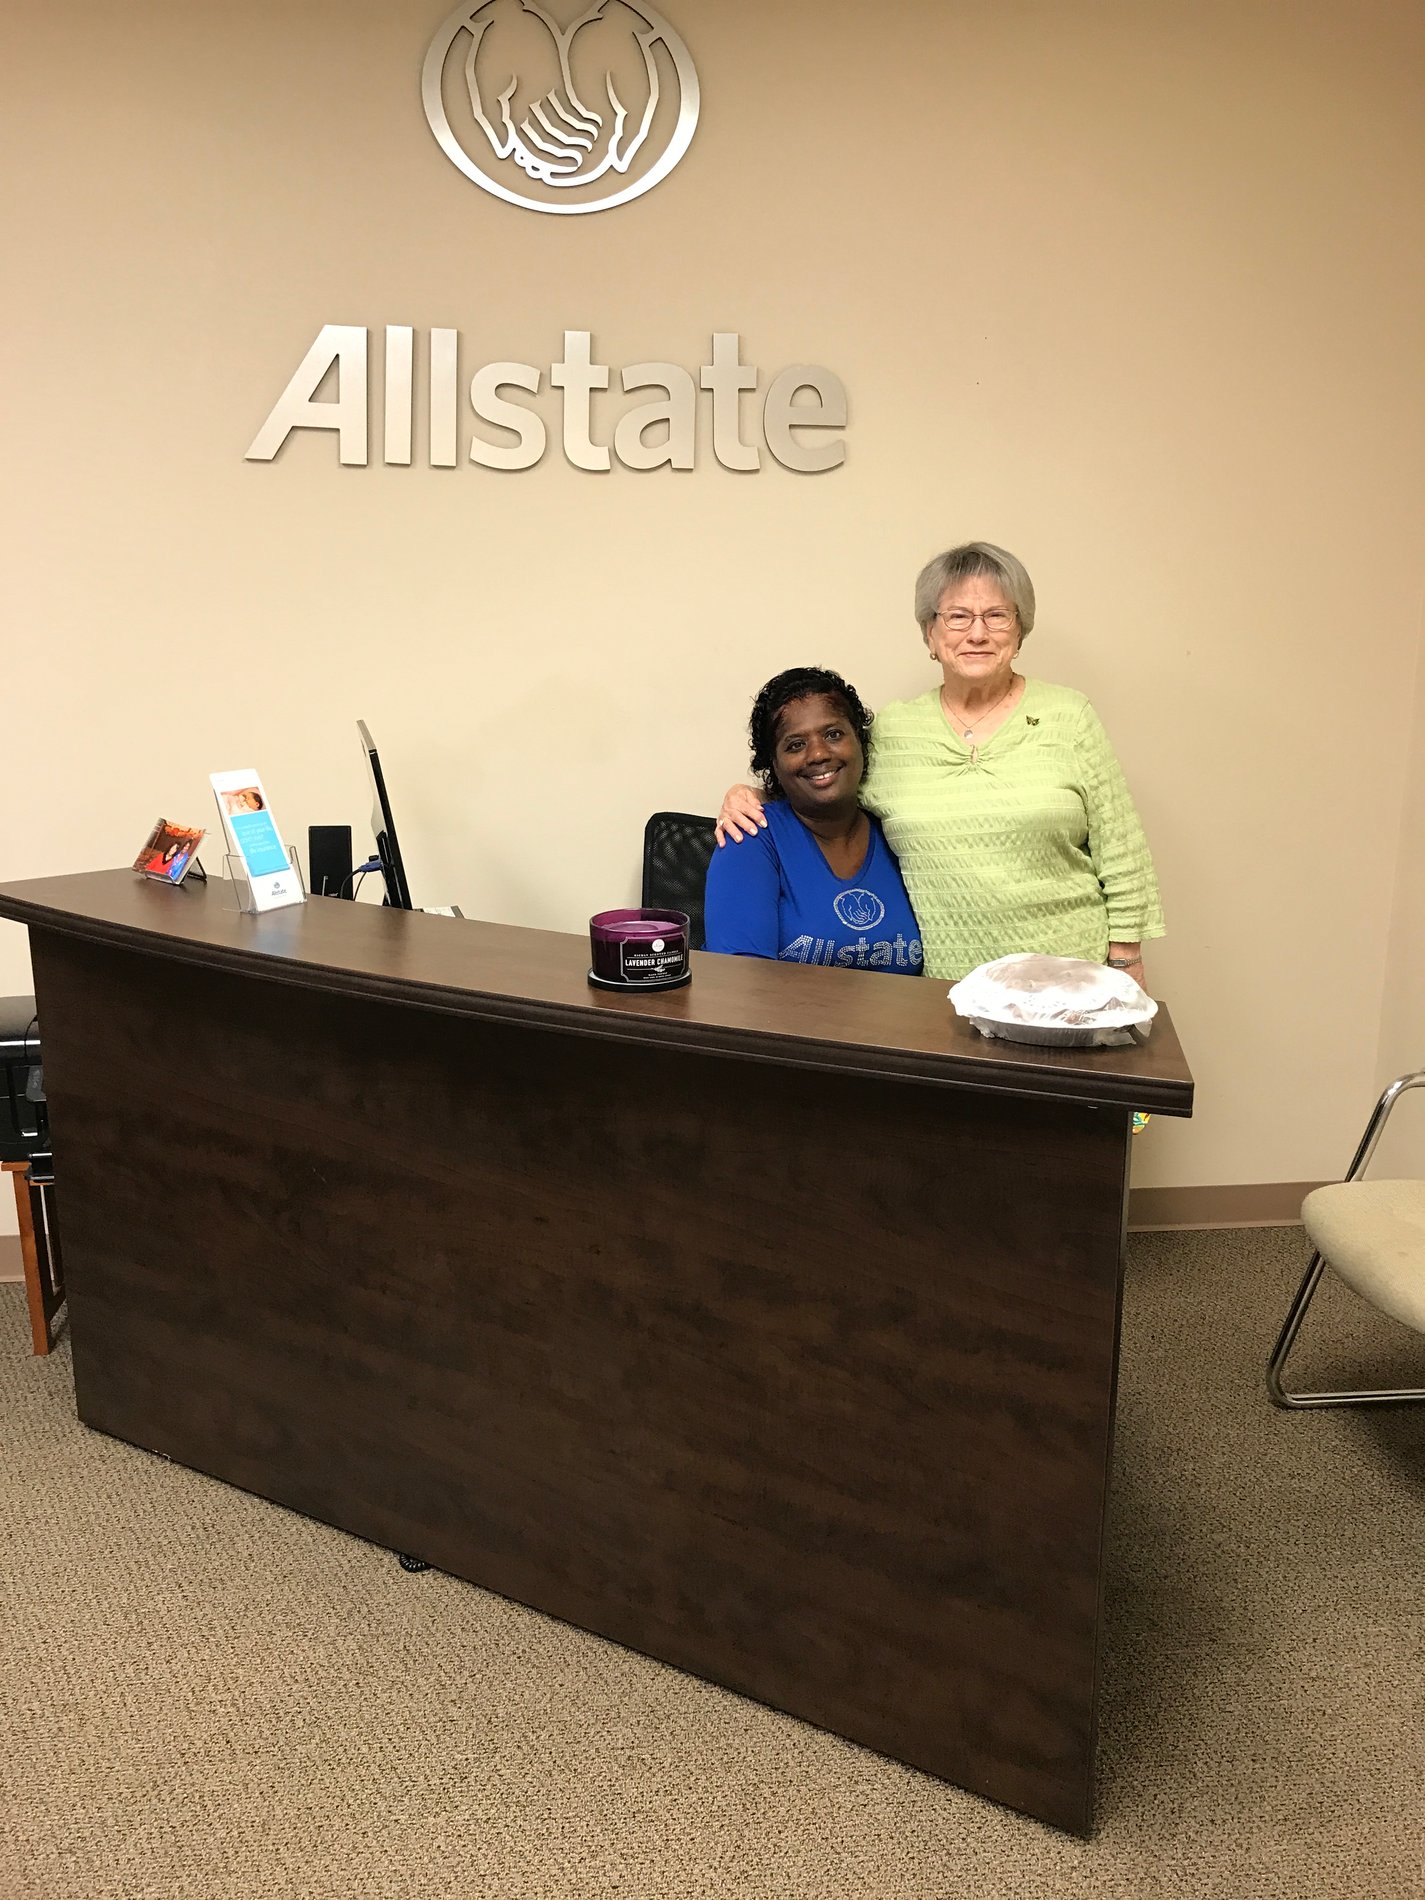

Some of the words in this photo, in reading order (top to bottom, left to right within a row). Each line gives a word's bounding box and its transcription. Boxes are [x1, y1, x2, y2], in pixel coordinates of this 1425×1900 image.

[243, 324, 850, 473] Allstate
[656, 954, 683, 965] CHAMOMILE
[778, 933, 923, 967] Allstate
